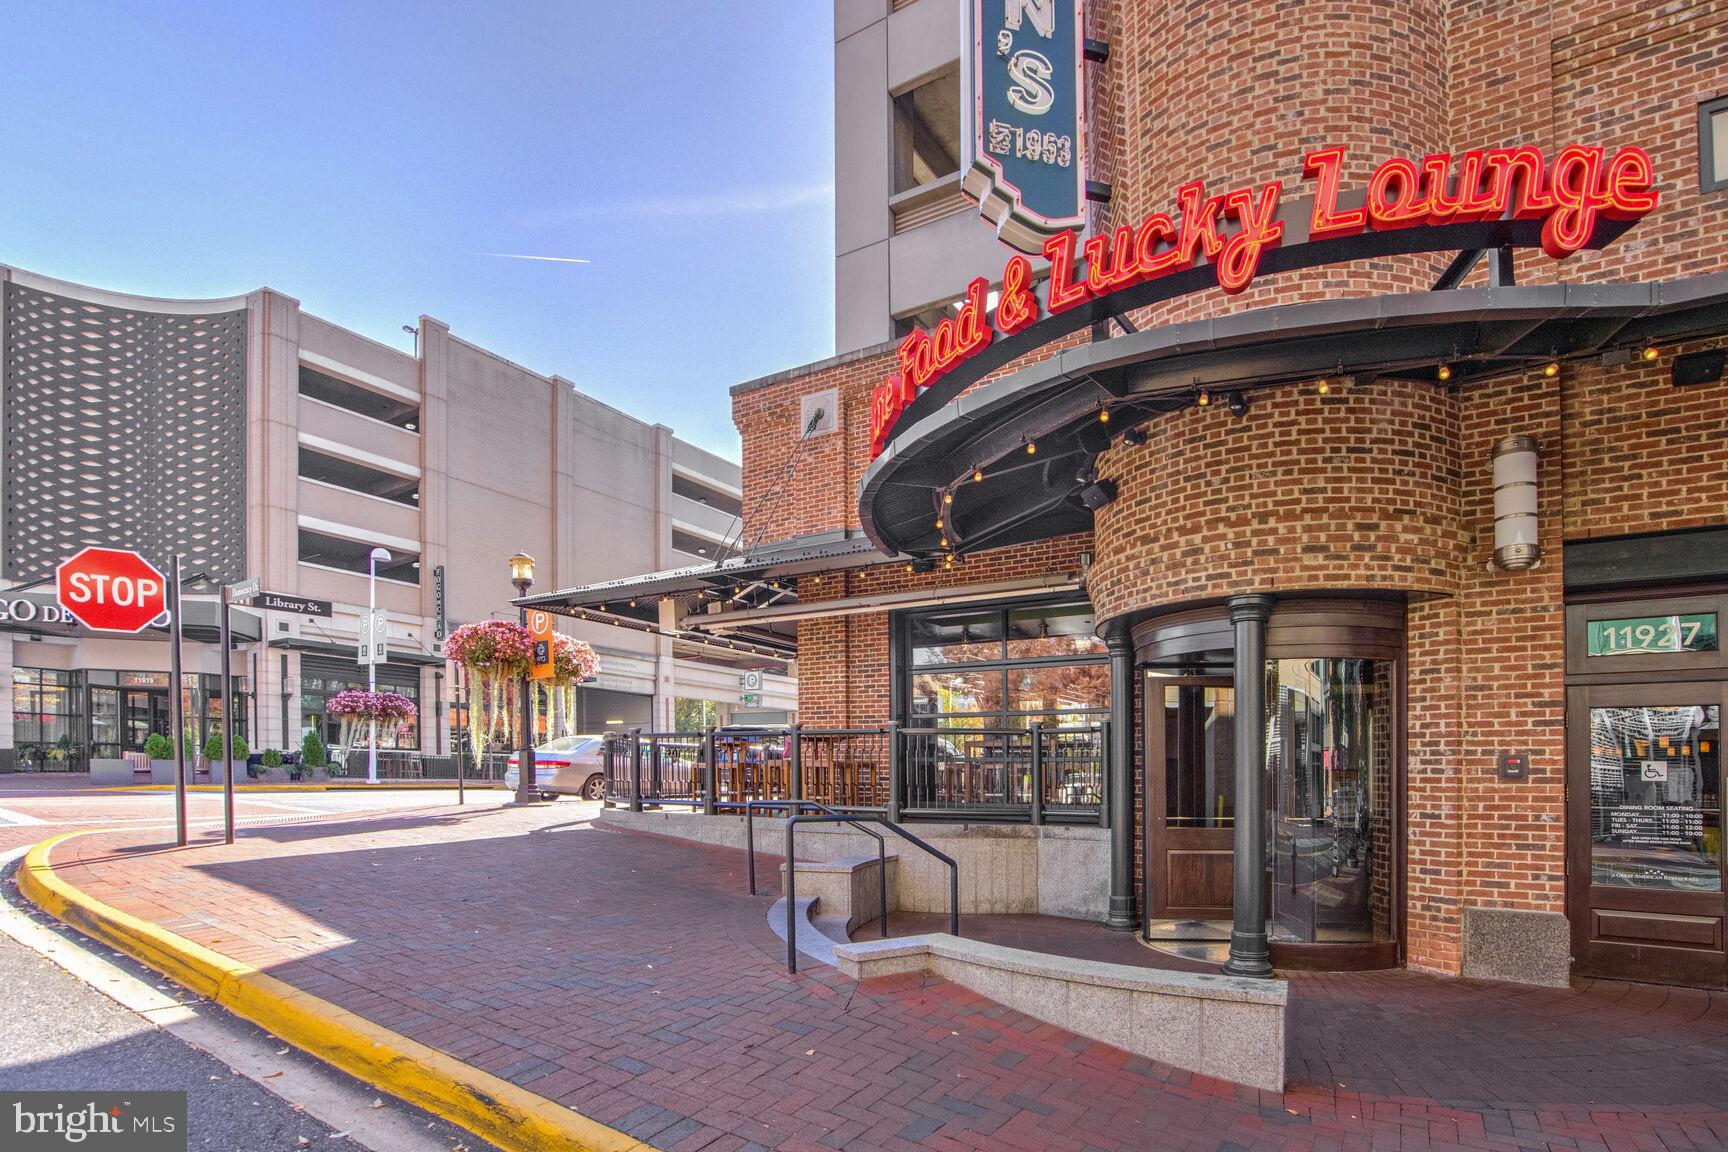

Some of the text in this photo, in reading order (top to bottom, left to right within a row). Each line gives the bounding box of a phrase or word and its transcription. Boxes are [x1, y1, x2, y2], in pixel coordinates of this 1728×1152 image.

[1015, 127, 1071, 168] 1953
[898, 276, 994, 405] Food
[996, 255, 1038, 336] &
[1041, 180, 1284, 316] Lucky
[1302, 144, 1660, 260] Lounge
[69, 572, 159, 607] STOP
[265, 597, 321, 612] Library St.
[1603, 622, 1700, 649] 11927
